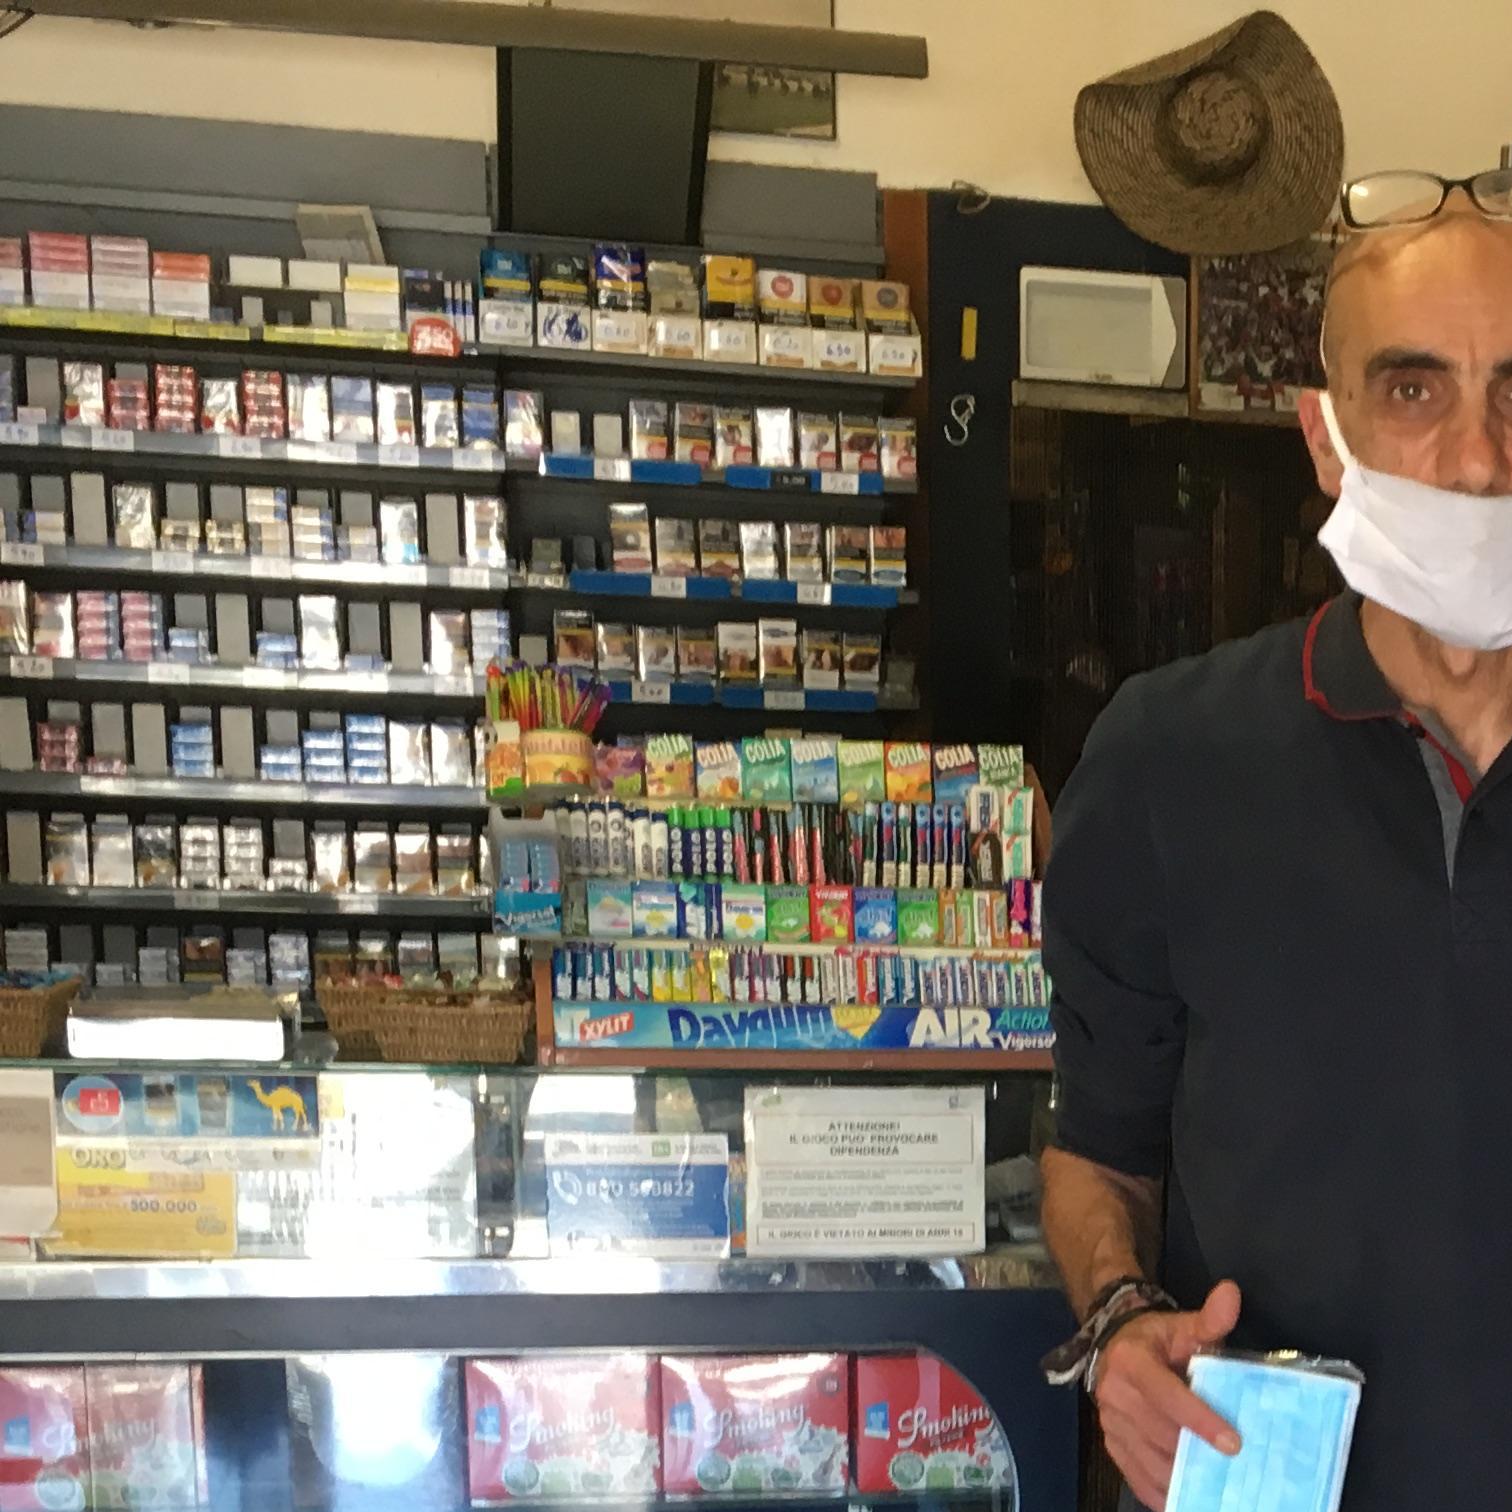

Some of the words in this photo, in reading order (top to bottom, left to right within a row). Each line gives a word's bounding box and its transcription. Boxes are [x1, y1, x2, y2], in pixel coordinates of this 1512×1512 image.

[745, 738, 786, 764] GOLIA
[935, 744, 974, 771] GOLIA
[583, 1013, 632, 1041] XYLIT
[909, 1007, 995, 1049] AIR
